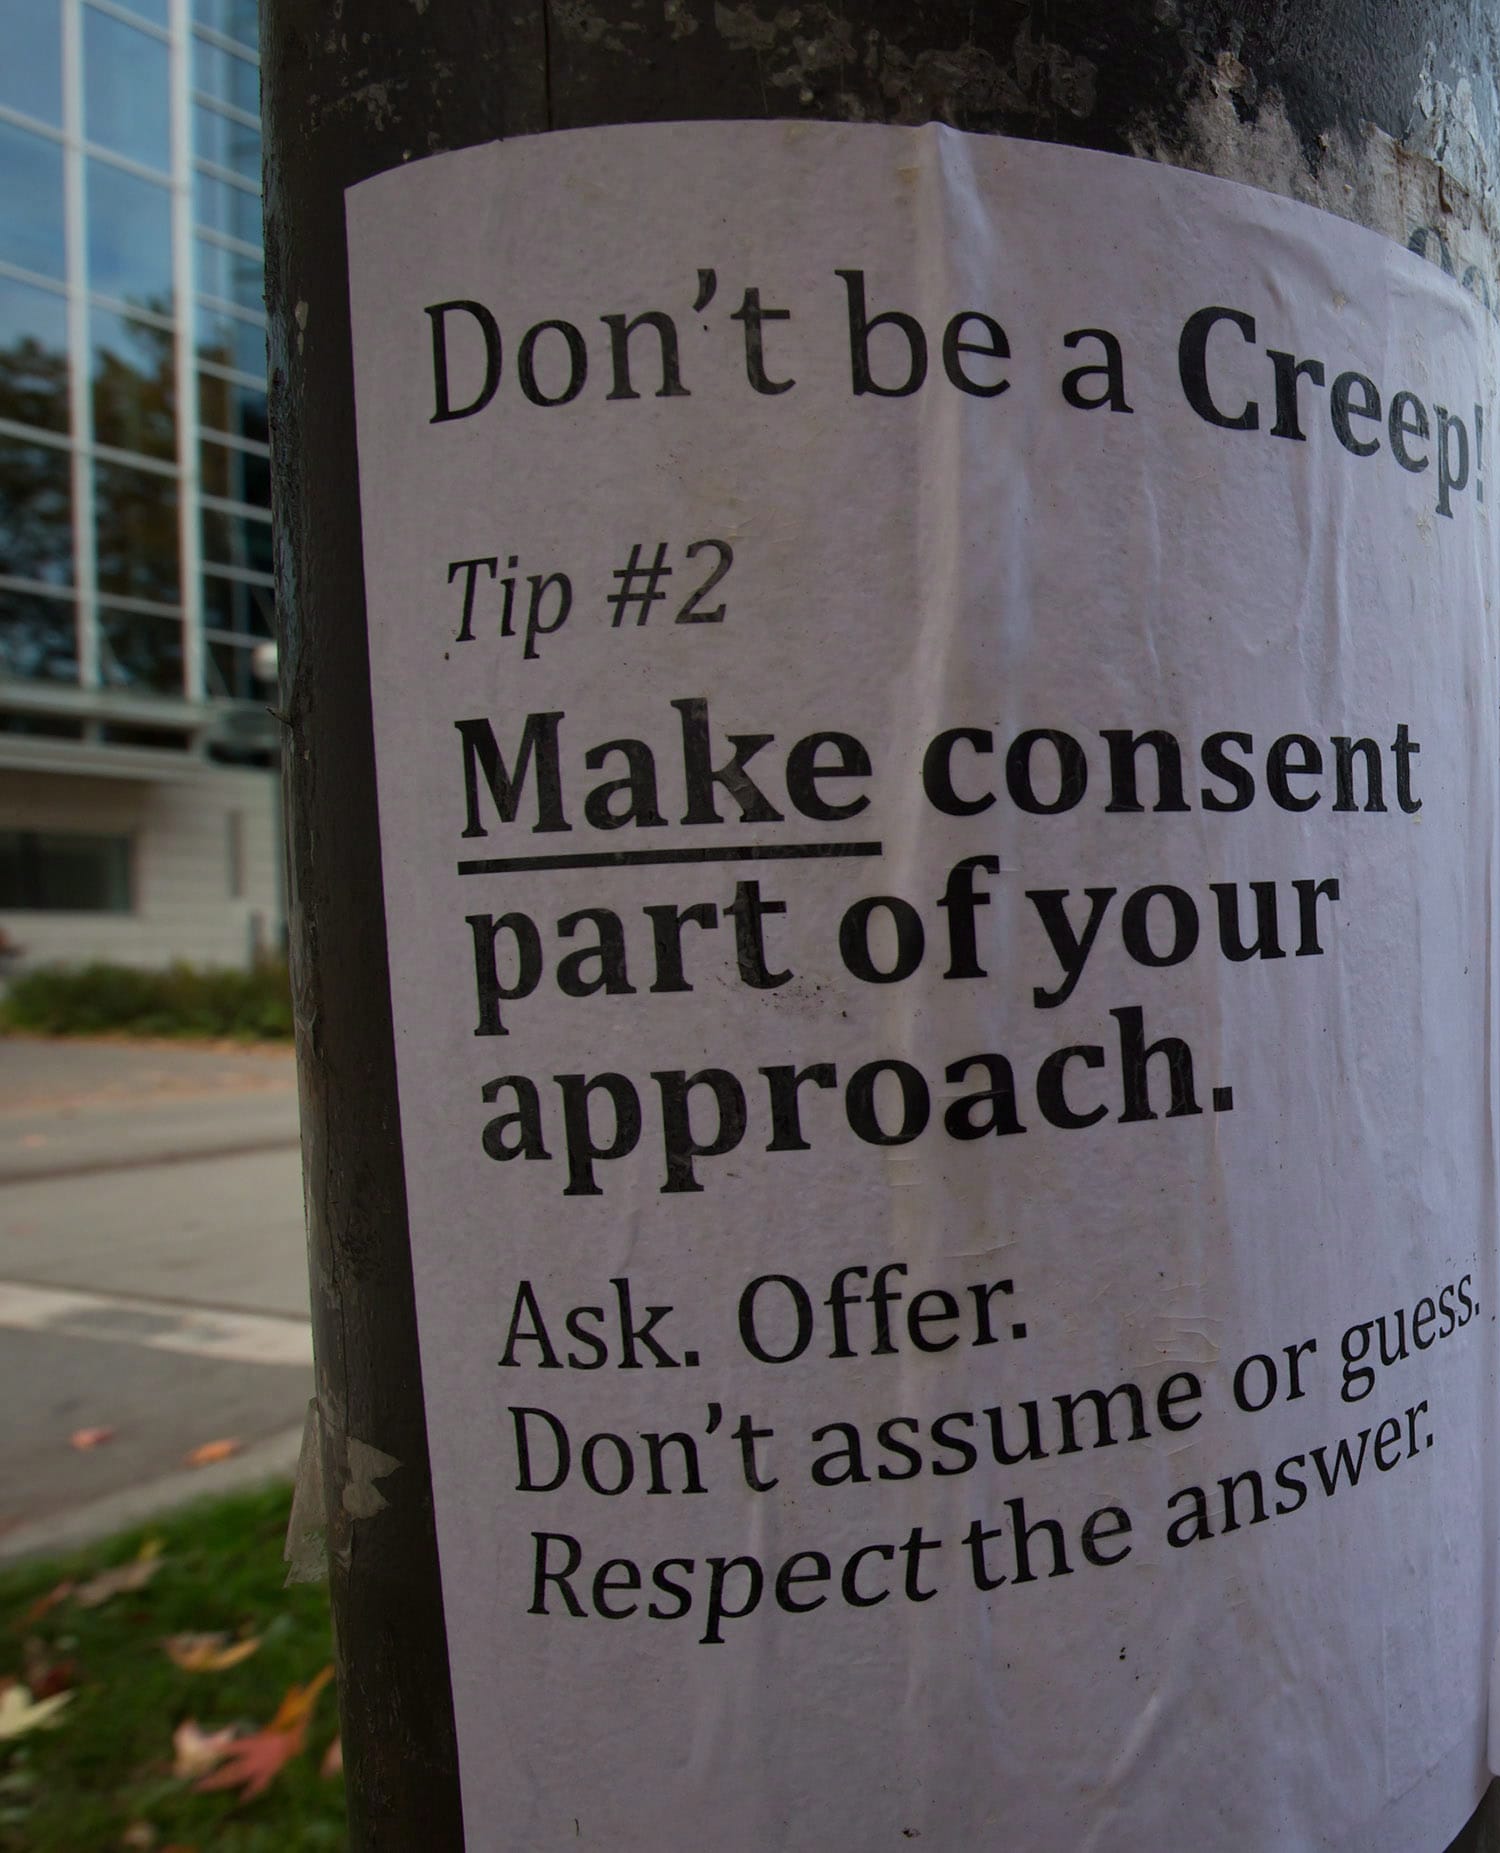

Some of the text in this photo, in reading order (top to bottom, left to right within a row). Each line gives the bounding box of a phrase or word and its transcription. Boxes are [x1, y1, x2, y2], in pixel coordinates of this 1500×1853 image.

[423, 268, 1485, 519] Don’t be a Creep!
[447, 538, 734, 660] Tip #2
[453, 696, 1423, 839] Make consent
[464, 854, 1341, 1037] part of your
[481, 1004, 1234, 1197] approach.
[497, 1262, 1028, 1371] Ask. Offer.
[507, 1273, 1481, 1497] Don’t assume or guess.
[526, 1399, 1434, 1645] Respect the answer.
